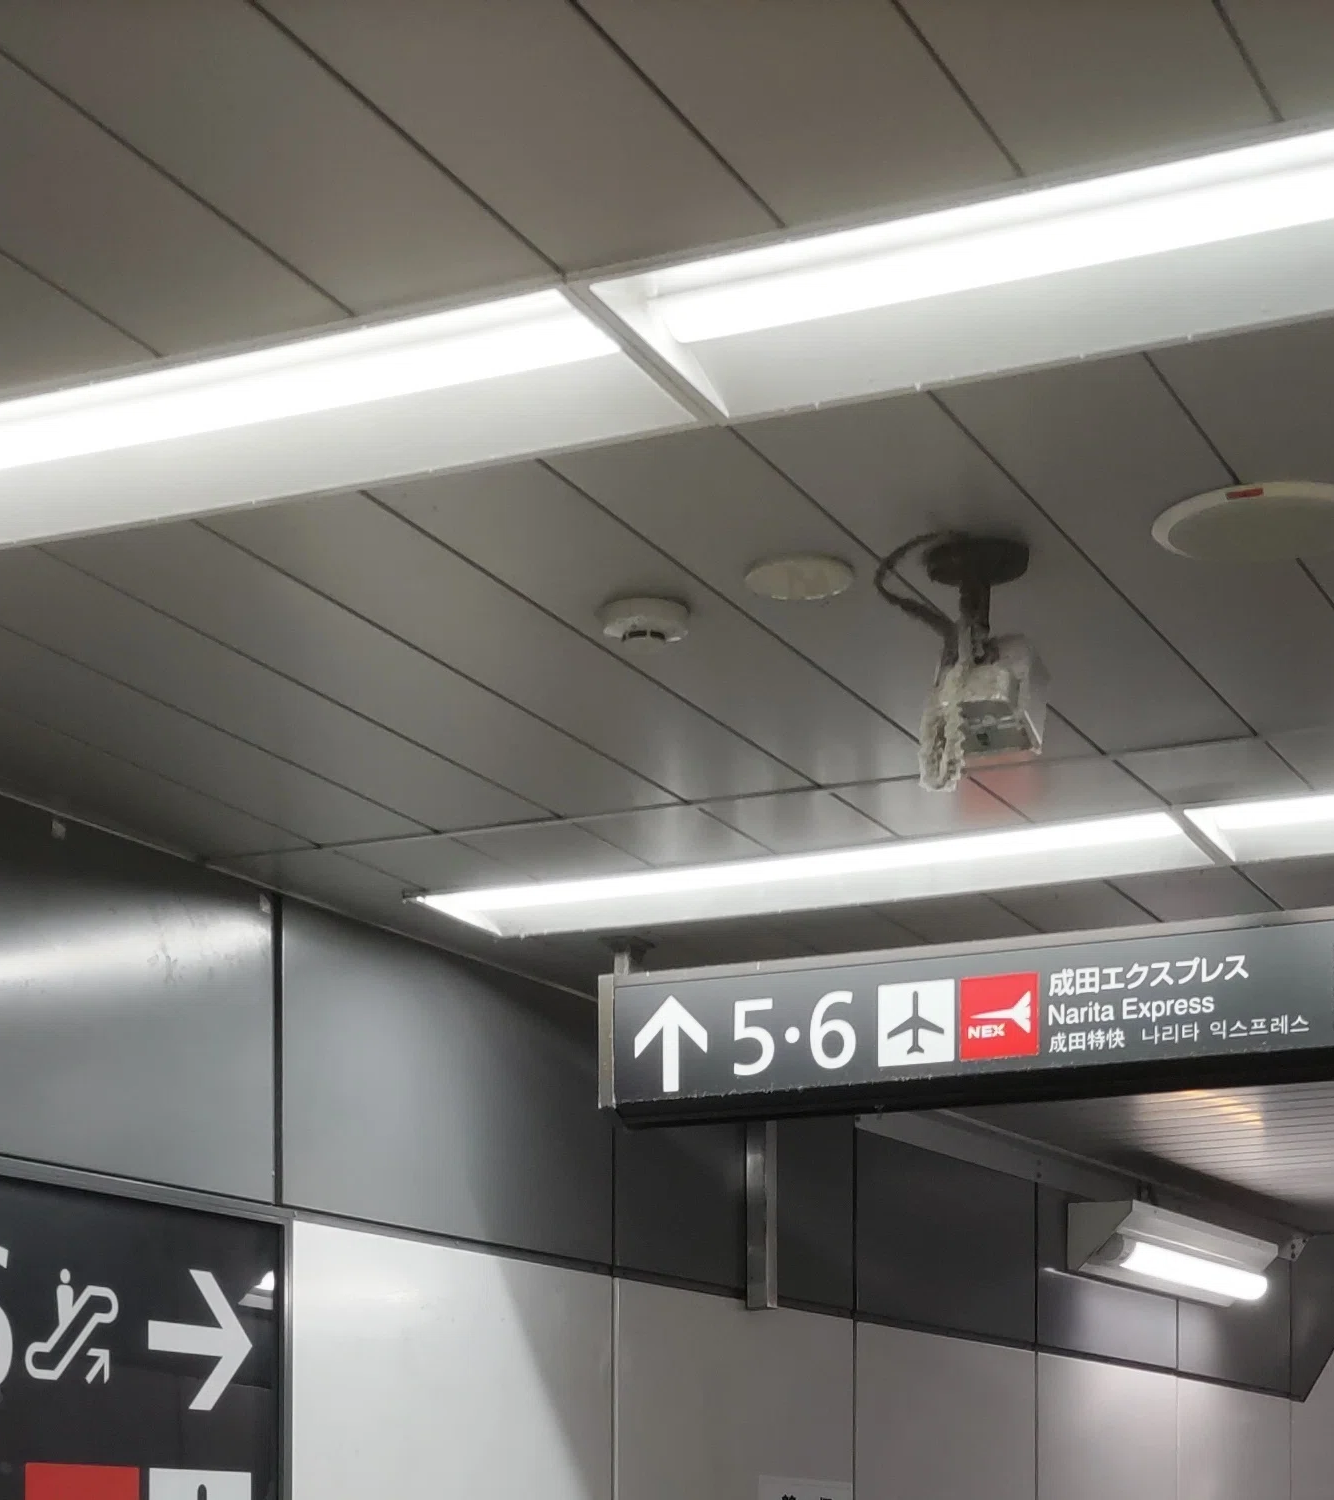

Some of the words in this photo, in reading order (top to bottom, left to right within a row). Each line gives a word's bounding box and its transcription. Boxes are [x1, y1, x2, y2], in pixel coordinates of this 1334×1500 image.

[1049, 955, 1248, 996] 成田エクスプレス
[1049, 1001, 1114, 1025] Narita
[1123, 996, 1214, 1022] Express
[1049, 1029, 1125, 1052] 成田特快
[1142, 1022, 1199, 1044] 나리타
[1210, 1015, 1309, 1039] 익스프레스
